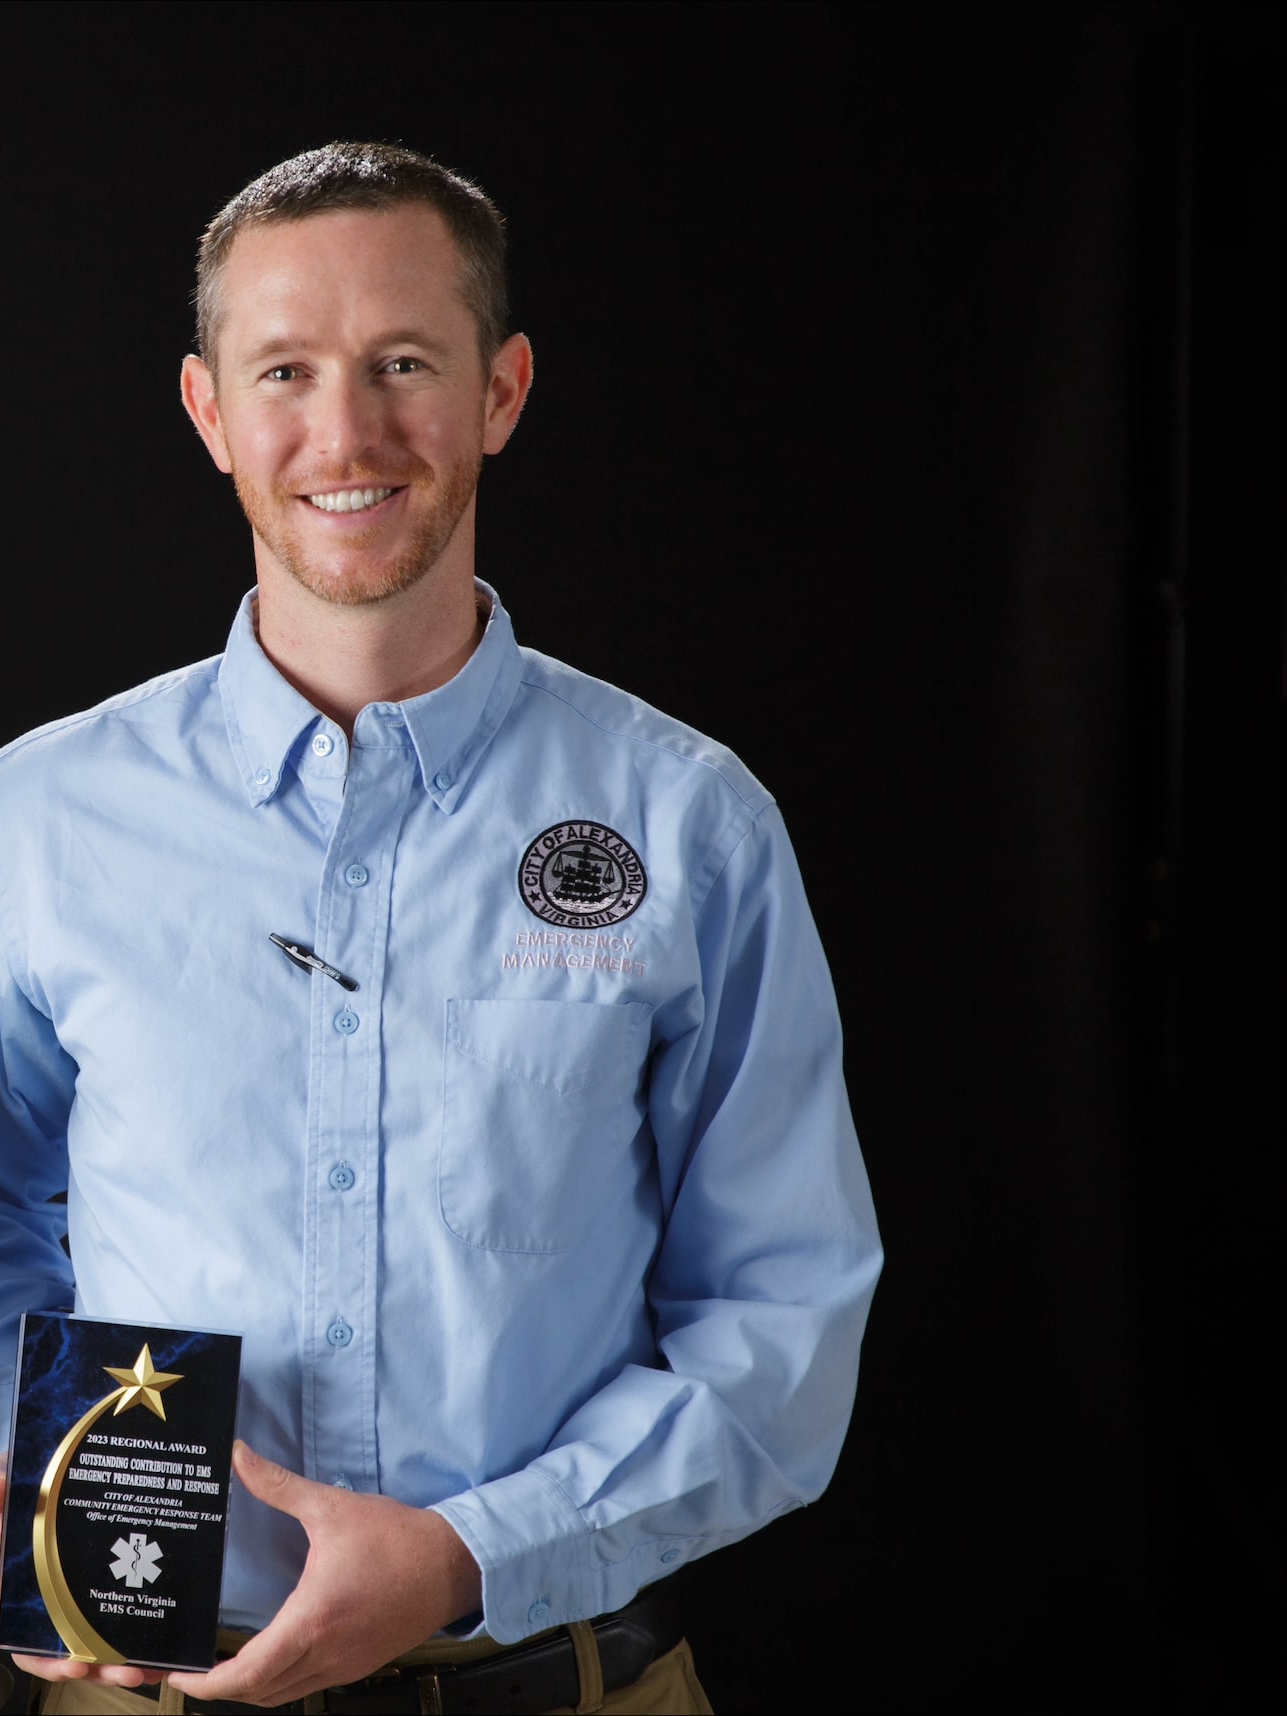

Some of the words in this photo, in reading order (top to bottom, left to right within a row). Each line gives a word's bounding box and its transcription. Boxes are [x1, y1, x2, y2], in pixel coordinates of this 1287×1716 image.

[524, 846, 545, 887] CITY
[543, 830, 564, 849] OF
[567, 825, 642, 895] ALEXANDRIA
[540, 903, 619, 926] VIRGINIA
[515, 932, 635, 952] EMERGENCY
[501, 953, 647, 976] MANAGEMENT
[87, 1434, 108, 1445] 2023
[110, 1435, 166, 1451] REGIONAL
[166, 1443, 207, 1455] AWARD
[79, 1453, 129, 1469] OUTSTANDING
[130, 1458, 183, 1475] CONTRIBUTION
[185, 1465, 194, 1476] TO
[196, 1466, 212, 1478] EMS
[68, 1467, 112, 1483] EMERGENCY
[113, 1473, 165, 1489] PREPAREDNESS
[167, 1479, 182, 1491] AND
[184, 1480, 220, 1495] RESPONSE
[63, 1498, 112, 1510] COMMUNITY
[111, 1502, 160, 1516] EMERGENCY
[159, 1509, 199, 1520] RESPONSE
[200, 1512, 222, 1522] TEAM
[104, 1491, 123, 1501] CITY
[123, 1493, 135, 1502] OF
[135, 1494, 183, 1507] ALEXANDRIA
[86, 1511, 107, 1522] Office
[107, 1514, 116, 1523] of
[116, 1514, 153, 1527] Emergency
[154, 1518, 198, 1531] Management
[89, 1588, 134, 1603] Northern
[137, 1593, 177, 1608] Virginia
[99, 1602, 125, 1615] EMS
[126, 1605, 165, 1619] Council
